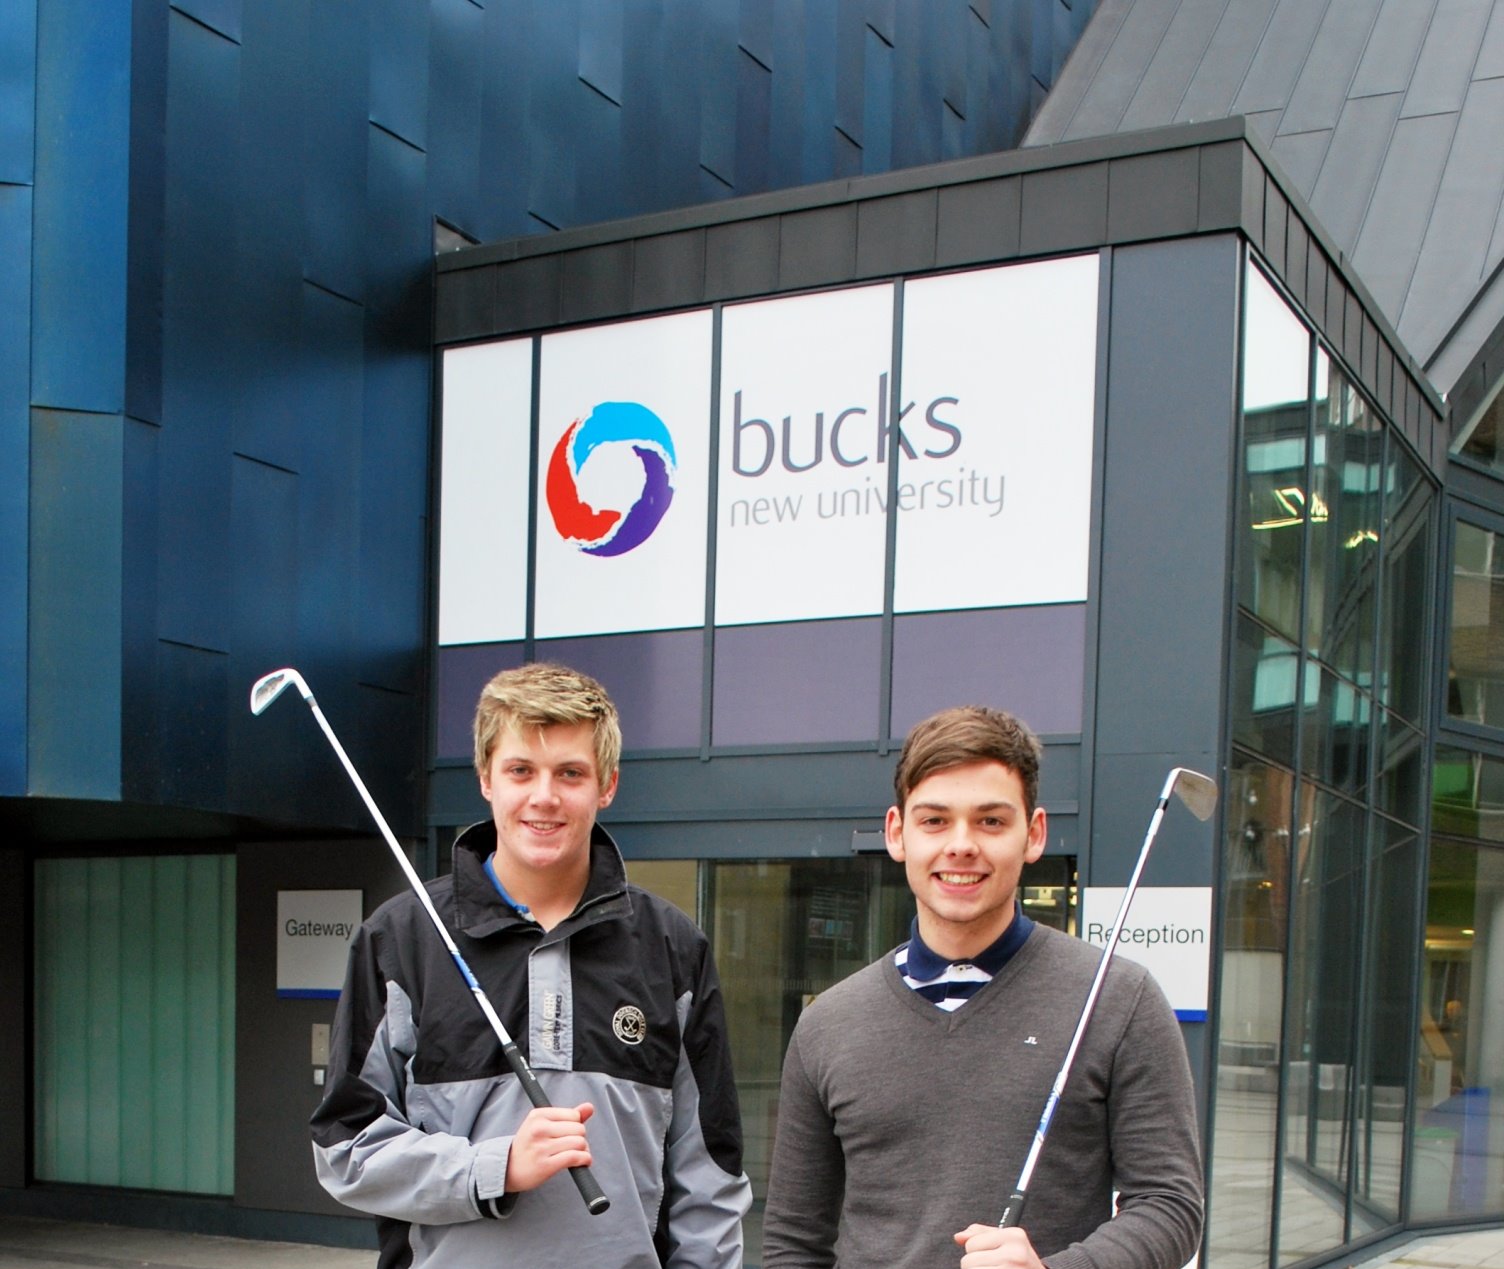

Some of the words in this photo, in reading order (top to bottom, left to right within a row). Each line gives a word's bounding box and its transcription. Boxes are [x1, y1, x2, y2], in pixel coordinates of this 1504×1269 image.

[732, 371, 962, 478] bucks
[730, 494, 803, 528] new
[817, 466, 1006, 519] university
[285, 918, 354, 941] Gateway
[1087, 922, 1205, 949] Reception
